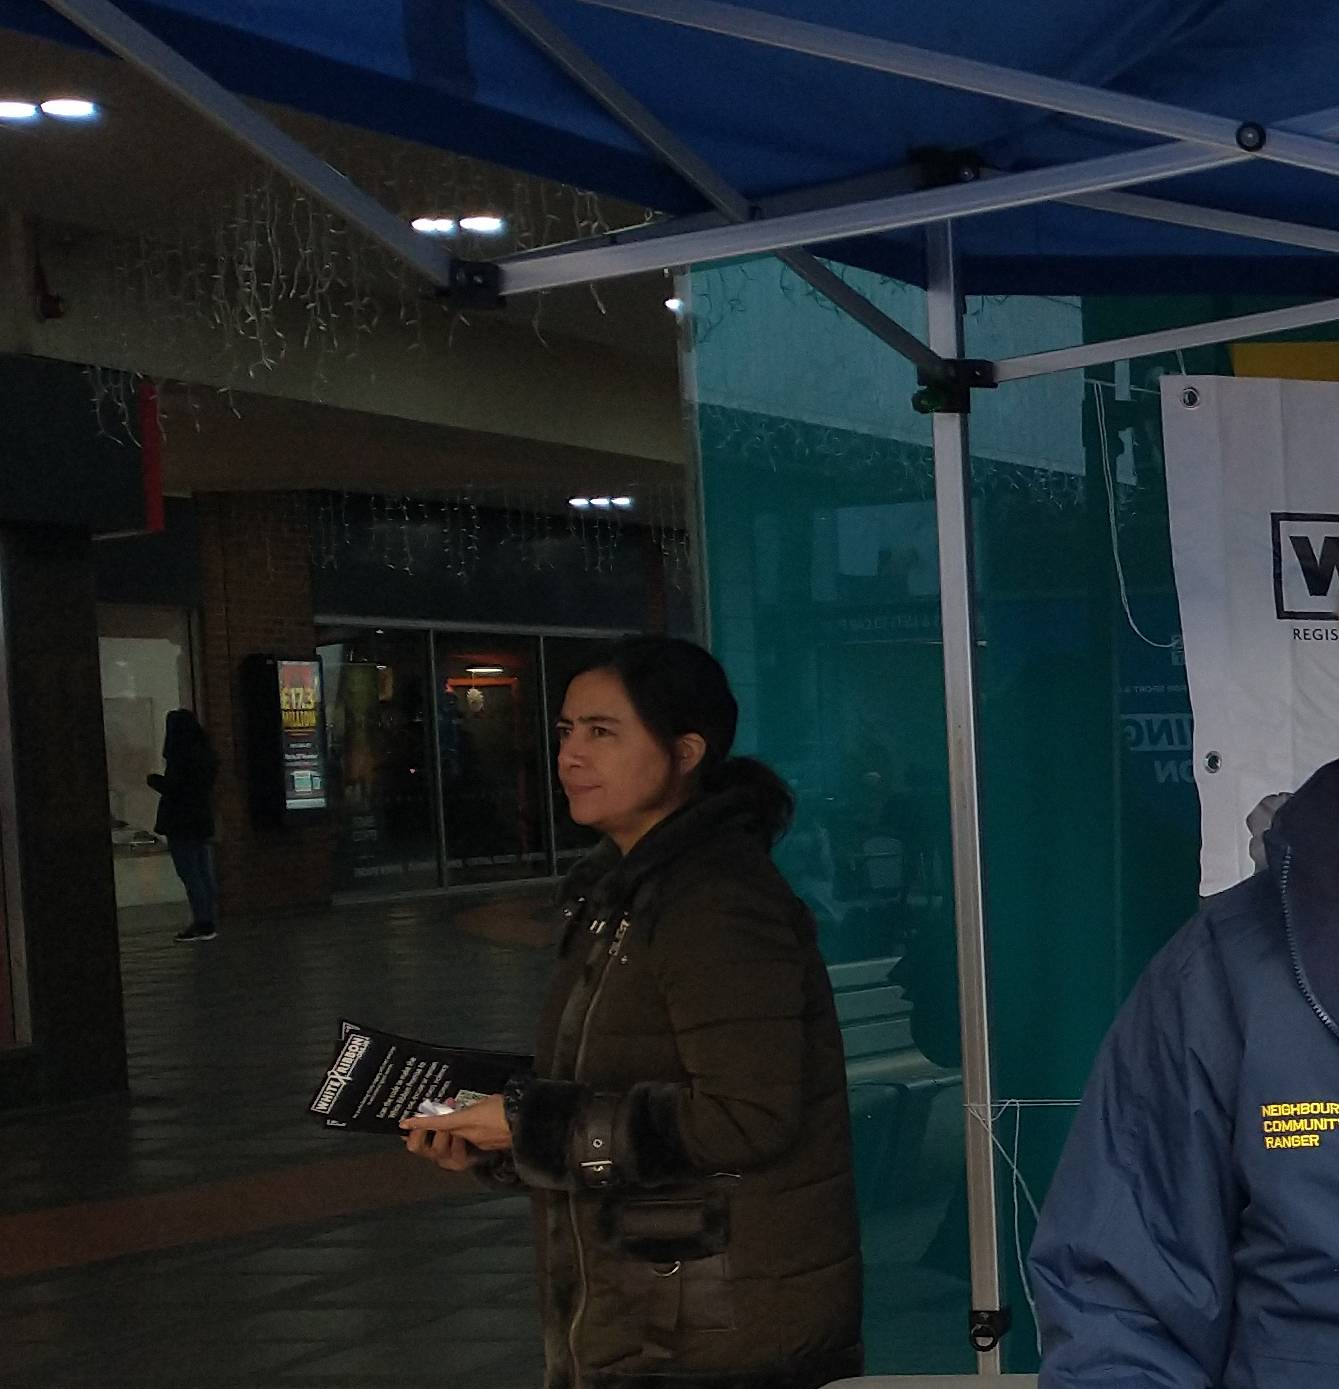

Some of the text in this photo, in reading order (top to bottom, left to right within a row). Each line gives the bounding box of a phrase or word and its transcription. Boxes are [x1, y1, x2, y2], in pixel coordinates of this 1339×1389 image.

[315, 1079, 341, 1111] WHITE
[337, 1037, 365, 1074] RIBBON
[1265, 1134, 1320, 1149] RANGER
